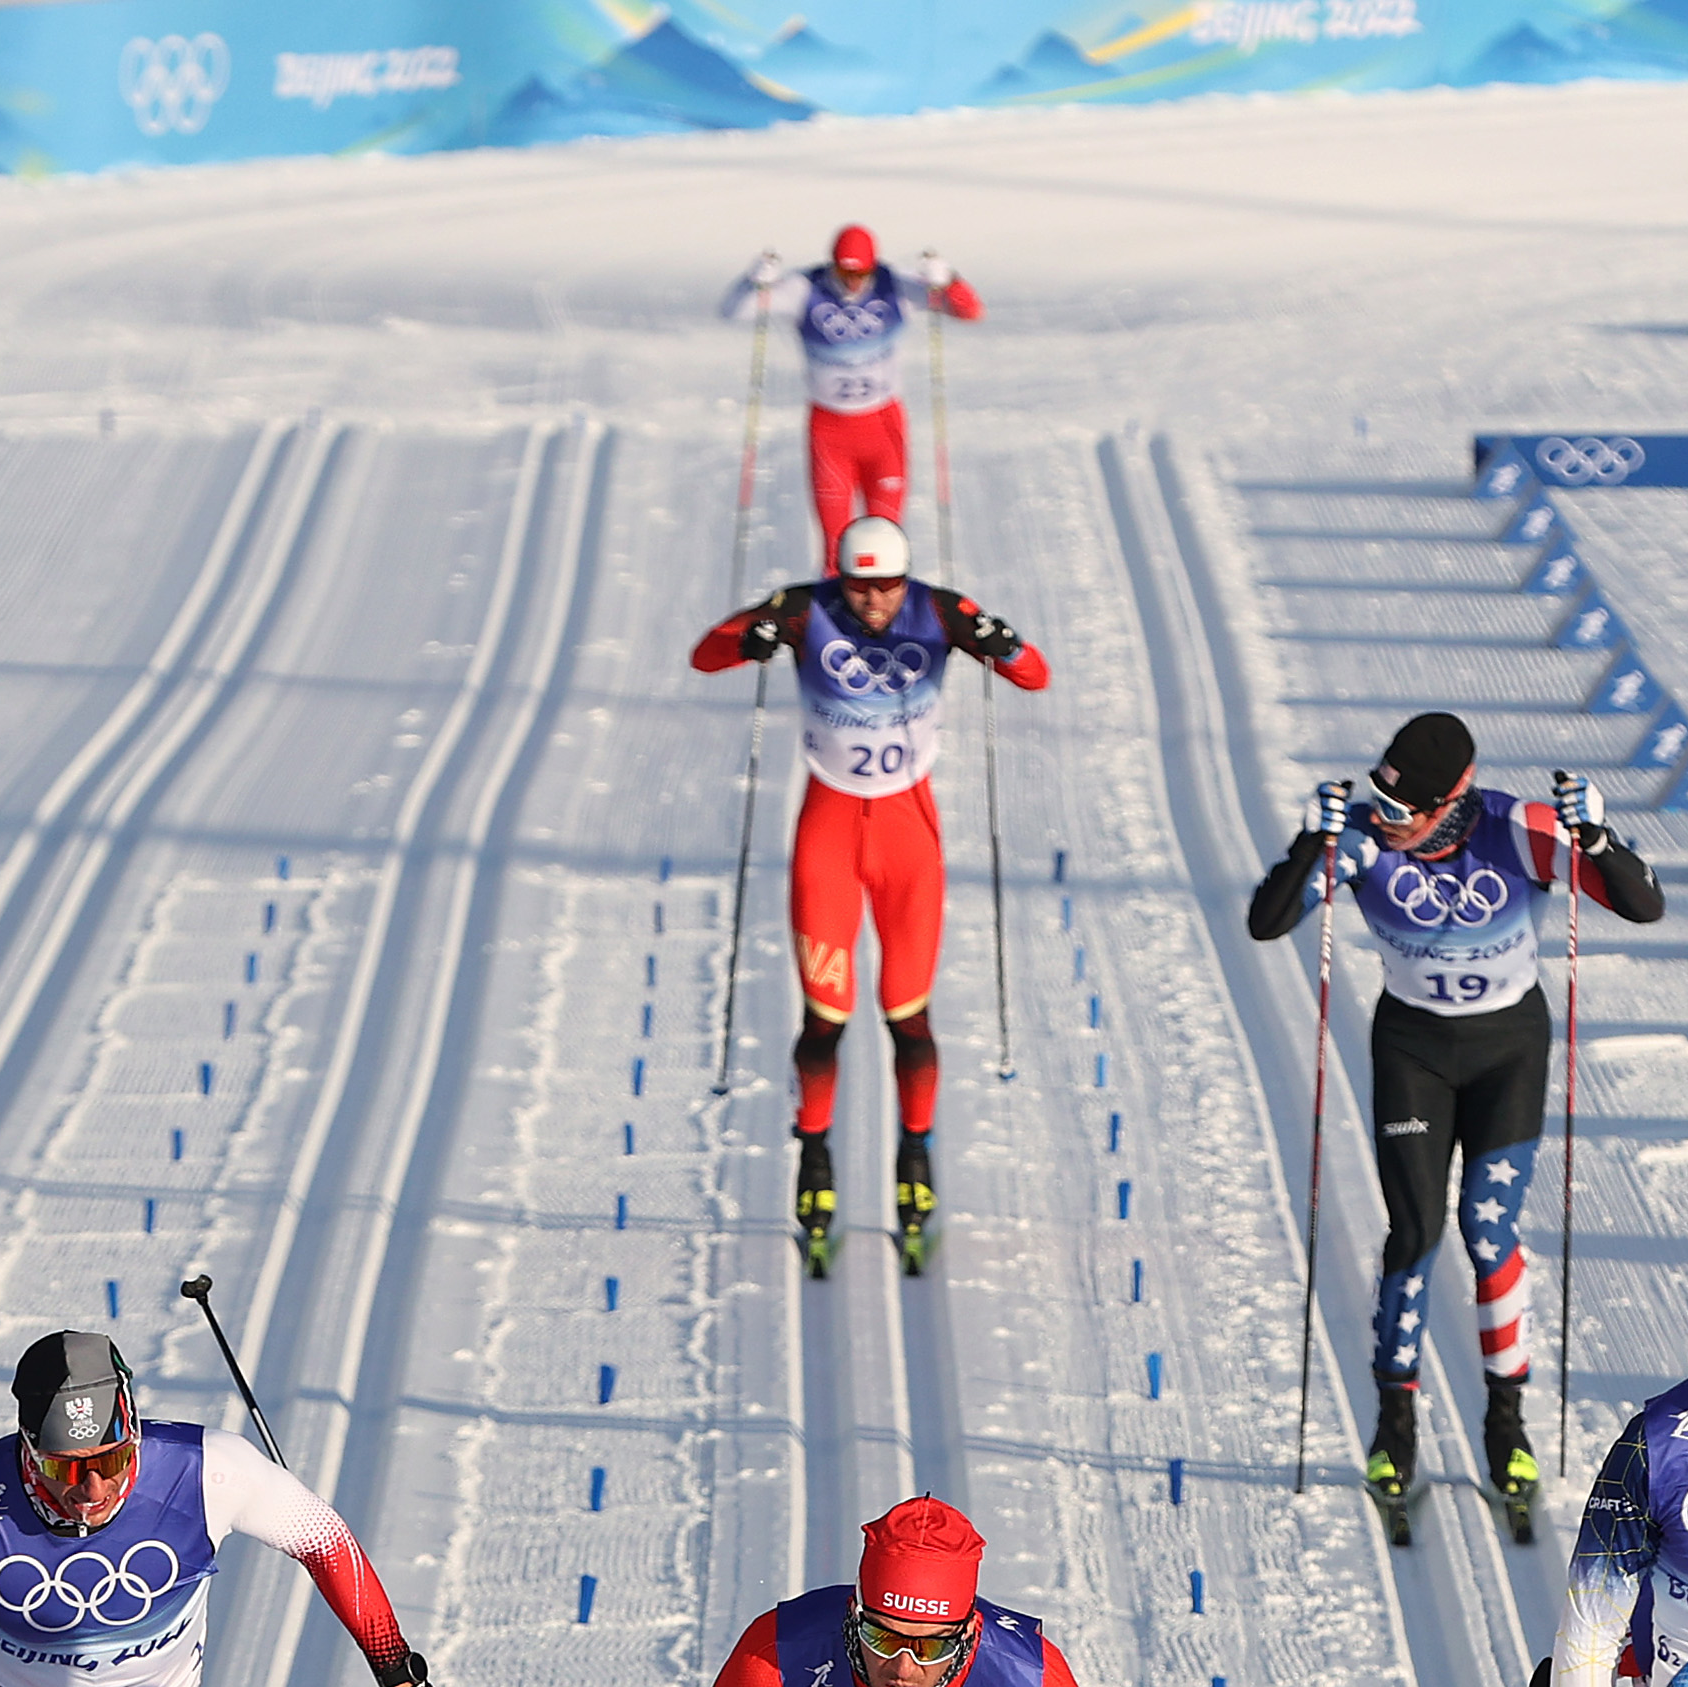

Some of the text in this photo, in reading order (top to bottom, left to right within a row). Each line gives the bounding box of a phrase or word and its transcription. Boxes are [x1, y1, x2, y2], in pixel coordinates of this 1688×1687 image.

[851, 744, 905, 777] 20
[1425, 972, 1489, 1001] 19
[1588, 1496, 1622, 1512] CRAFT
[882, 1592, 950, 1616] SUISSE
